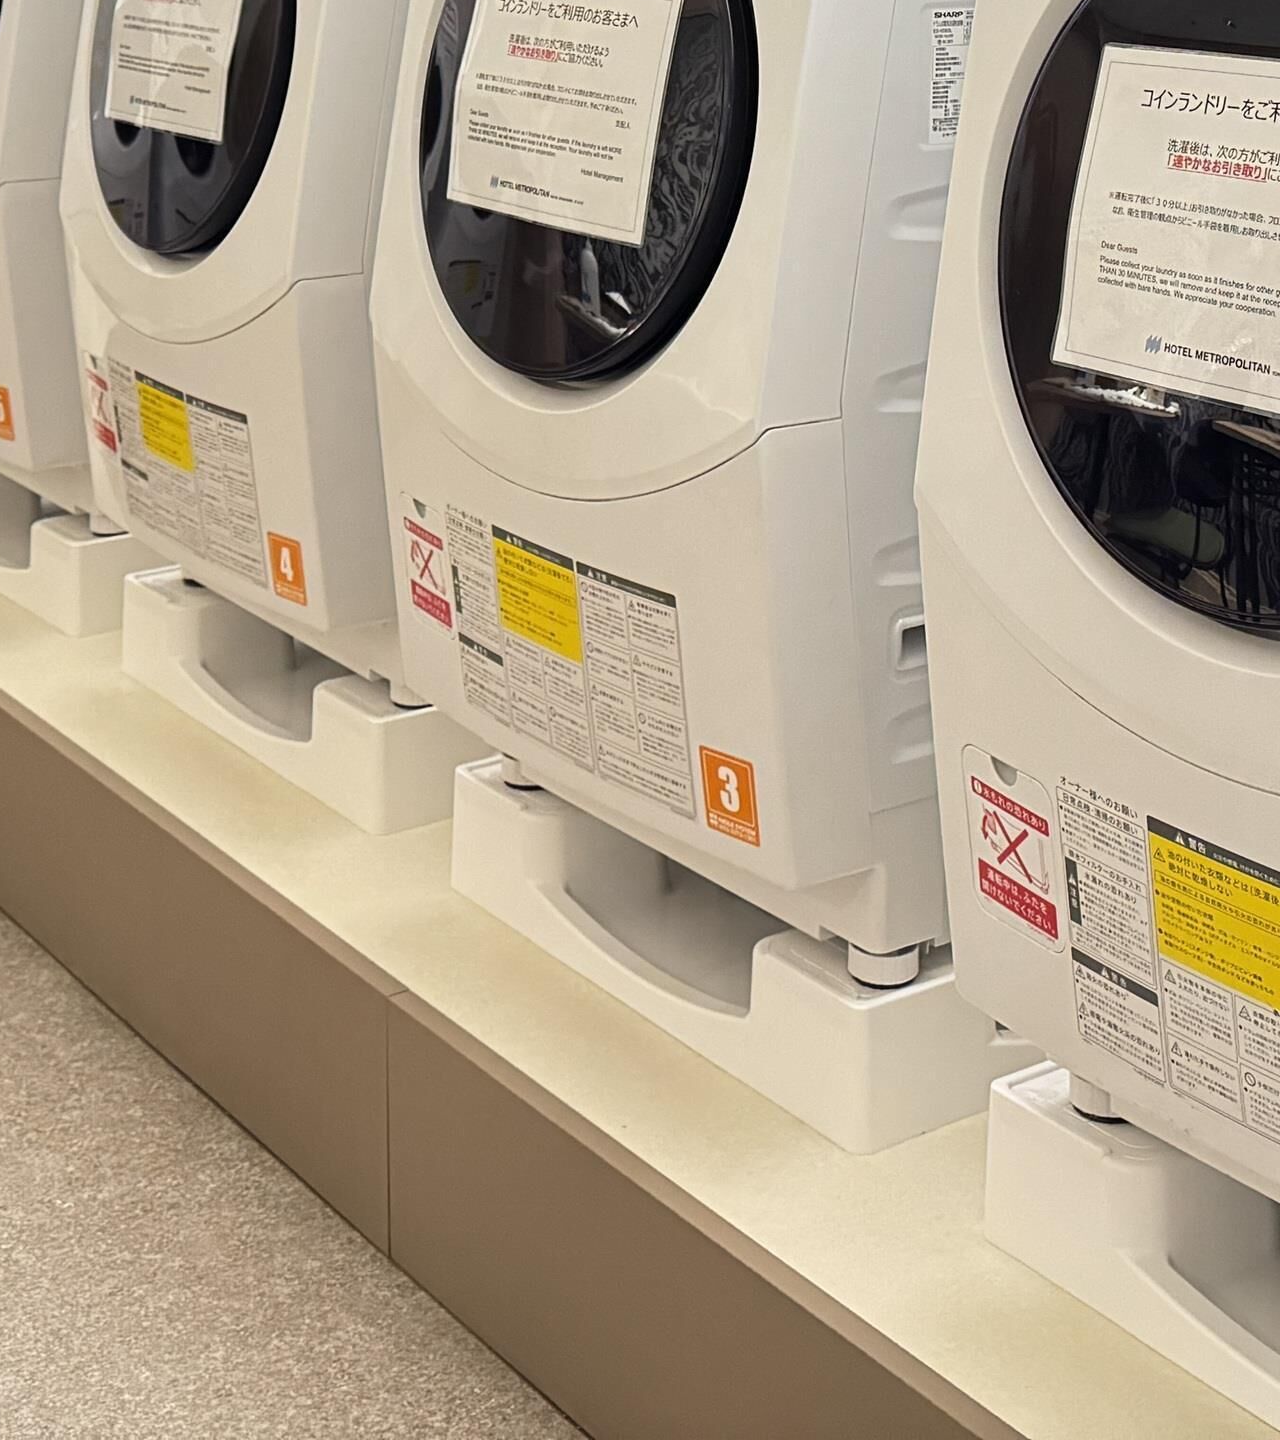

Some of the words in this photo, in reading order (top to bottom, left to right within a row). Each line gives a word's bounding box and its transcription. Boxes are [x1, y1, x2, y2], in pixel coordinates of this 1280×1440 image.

[500, 180, 514, 190] HOTEL
[515, 182, 550, 198] METROPOLITAN
[1101, 241, 1116, 250] Dear
[1117, 244, 1138, 254] Guests
[1097, 276, 1123, 287] collected
[1125, 281, 1136, 289] with
[1138, 283, 1152, 293] bare
[1152, 286, 1171, 297] hands.
[1173, 290, 1183, 299] We
[1185, 293, 1218, 305] appreciate
[1099, 265, 1117, 276] THAN
[1127, 270, 1158, 284] MINUTES,
[1100, 255, 1119, 266] Please
[1121, 260, 1140, 270] collect
[1141, 265, 1154, 273] your
[1156, 265, 1178, 278] laundry
[1188, 273, 1203, 282] soon
[1219, 277, 1244, 289] finishes
[1257, 286, 1274, 295] other
[1164, 343, 1193, 358] HOTEL
[1195, 349, 1271, 374] METROPOLITAN
[280, 546, 294, 582] 4
[718, 765, 741, 813] 3
[1060, 776, 1138, 819] オーナー様へのお願い
[983, 787, 1046, 831] 水もれの恐れあり
